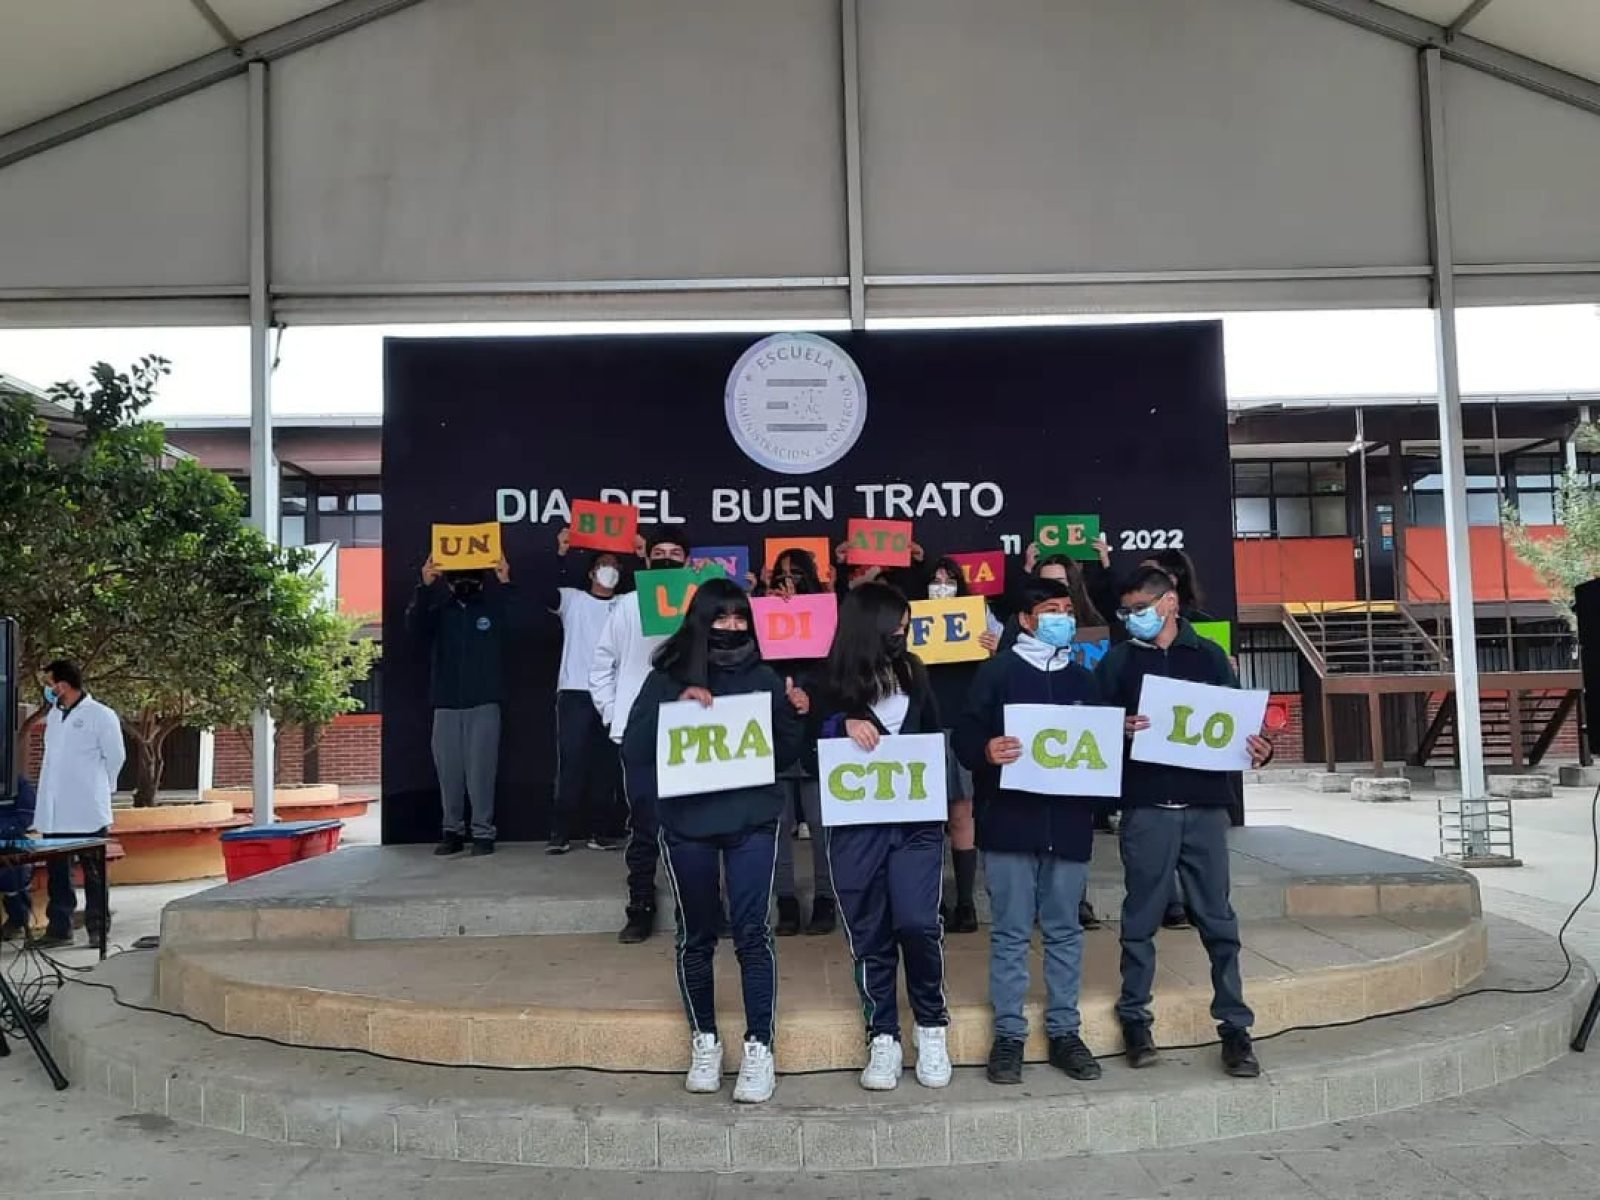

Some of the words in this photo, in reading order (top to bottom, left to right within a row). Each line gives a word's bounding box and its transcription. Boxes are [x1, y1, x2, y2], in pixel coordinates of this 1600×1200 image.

[756, 346, 834, 372] ESCUELA
[496, 488, 572, 523] DIA
[712, 485, 834, 523] BUEN
[855, 482, 1004, 518] TRATO
[577, 513, 627, 537] BU
[1039, 523, 1087, 546] CE
[1120, 529, 1184, 551] 2022
[439, 534, 491, 556] UN
[852, 529, 908, 552] ATO
[767, 611, 811, 641] DI
[911, 612, 970, 646] FE
[1167, 705, 1235, 749] LO
[666, 718, 773, 767] PRA
[1030, 728, 1108, 770] CA
[827, 761, 927, 802] CTI
